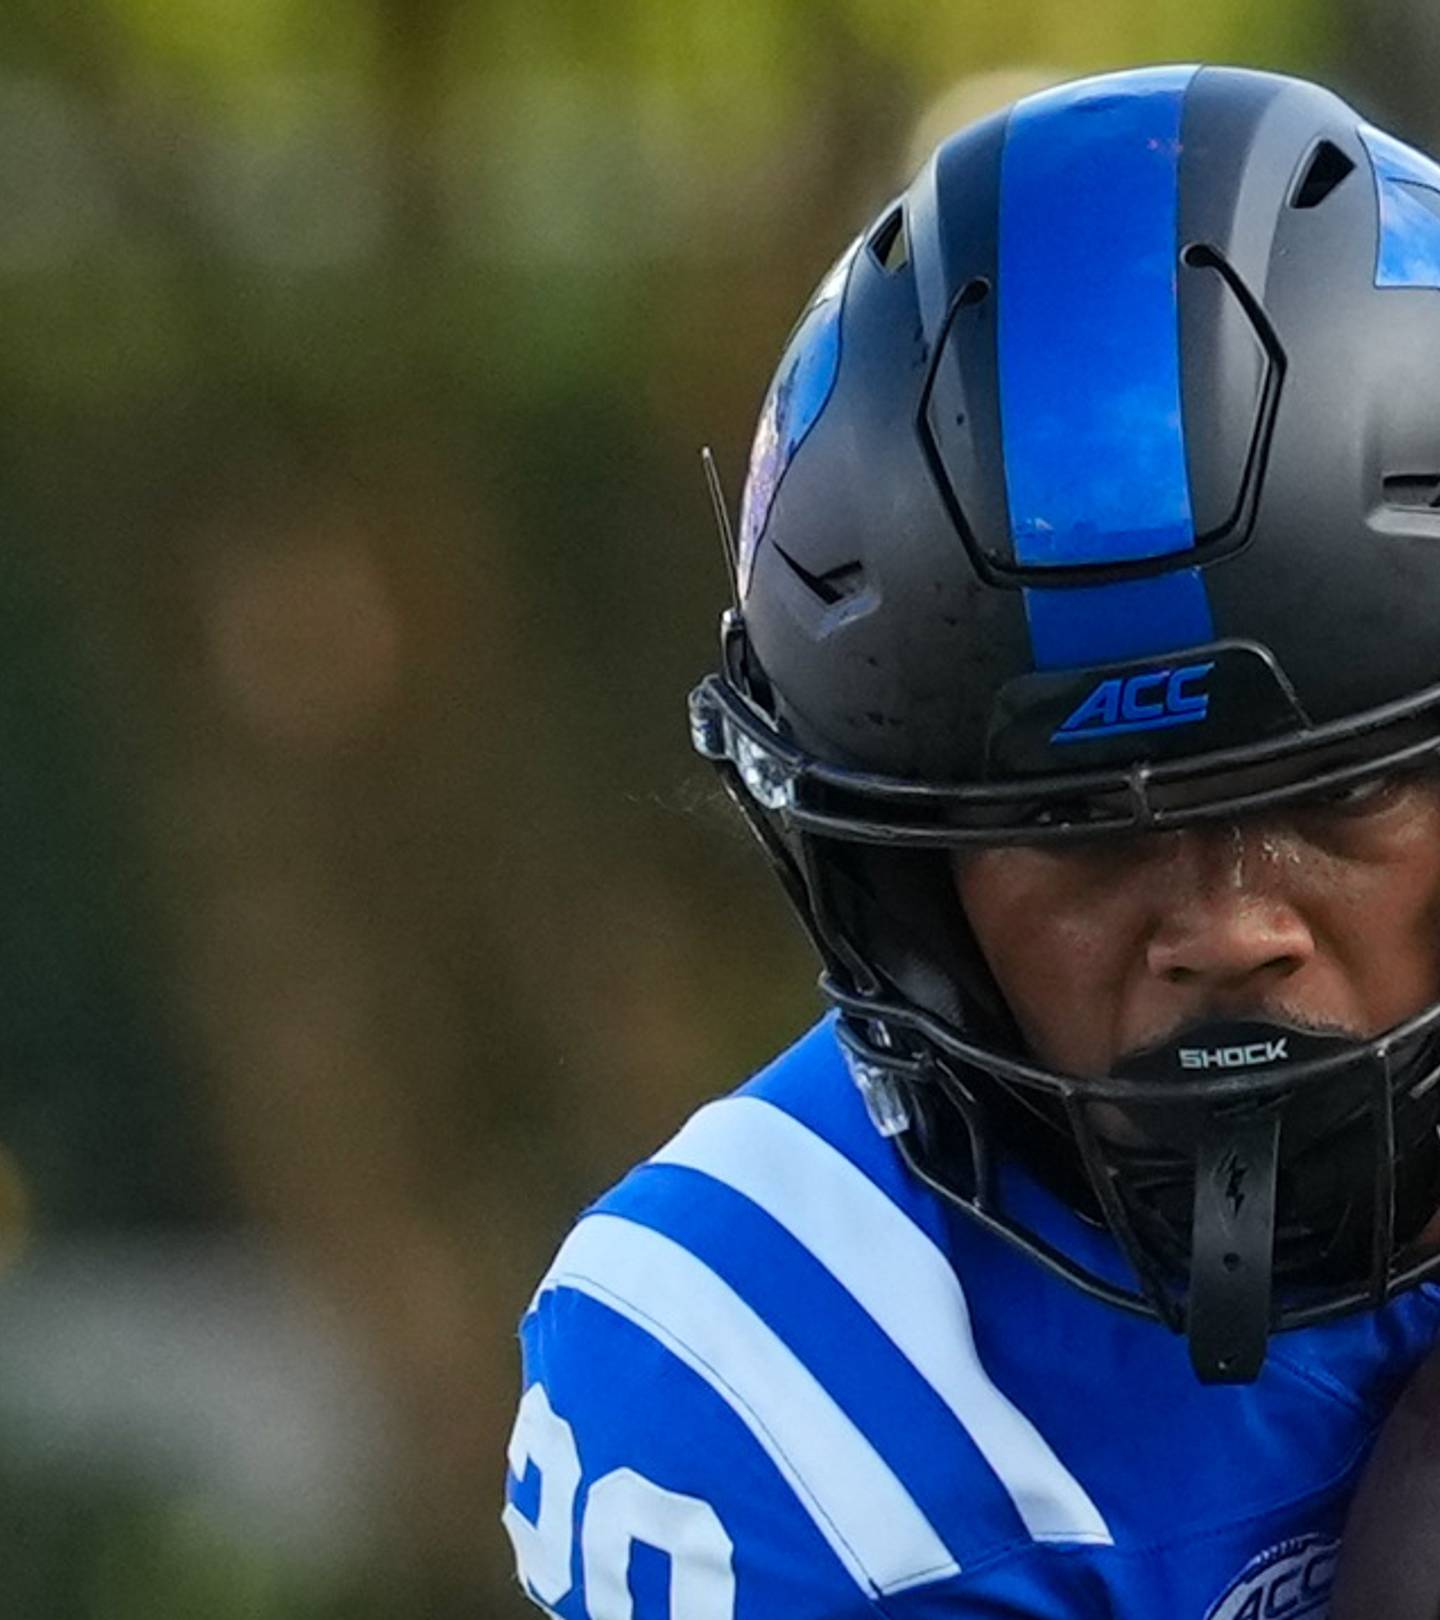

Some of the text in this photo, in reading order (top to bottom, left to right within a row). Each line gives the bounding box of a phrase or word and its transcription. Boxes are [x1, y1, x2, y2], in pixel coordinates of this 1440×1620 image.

[1056, 662, 1215, 734] ACC
[1179, 1037, 1288, 1069] SHOCK
[501, 1380, 736, 1620] 20
